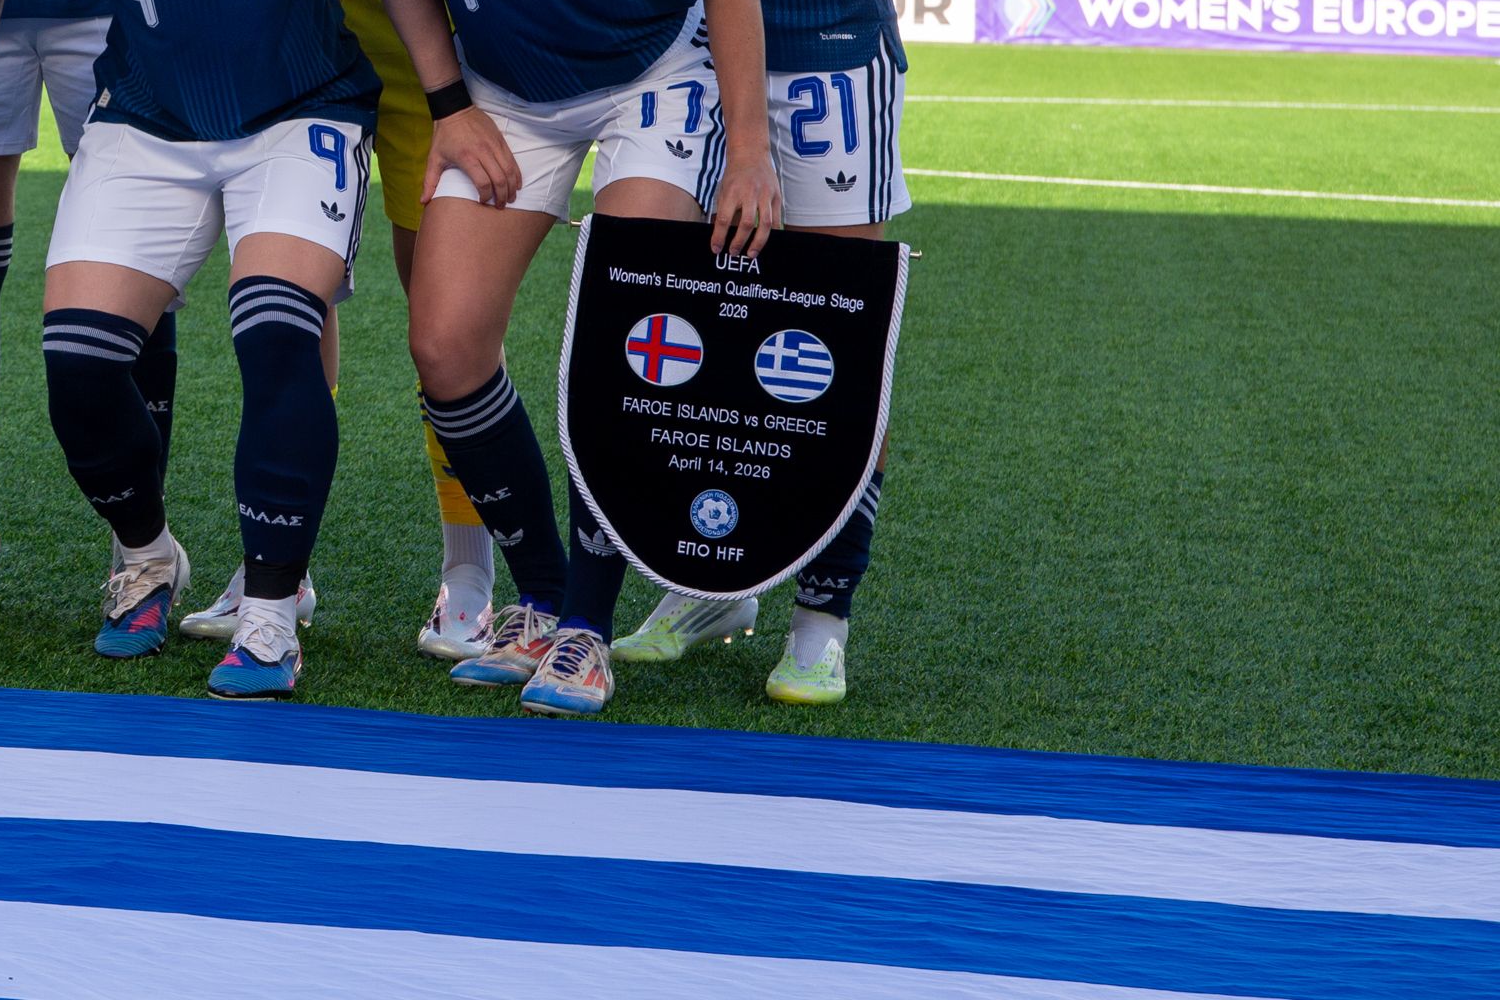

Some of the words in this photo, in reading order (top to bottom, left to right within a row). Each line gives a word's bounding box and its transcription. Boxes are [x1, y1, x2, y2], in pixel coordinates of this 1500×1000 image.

[787, 72, 861, 158] 21
[307, 123, 349, 193] 9
[715, 253, 760, 274] UEFA
[609, 266, 662, 287] Women's
[666, 273, 722, 294] European
[725, 281, 826, 308] Qualifiers-League
[830, 293, 865, 313] Stage
[718, 303, 749, 319] 2026
[622, 396, 672, 416] FAROE
[677, 404, 739, 424] ISLANDS
[744, 415, 759, 427] vs
[763, 415, 827, 436] GREECE
[651, 429, 710, 448] FAROE
[716, 436, 791, 459] ISLANDS
[668, 455, 702, 473] April
[707, 459, 729, 476] 14,
[734, 463, 771, 479] 2026
[239, 503, 304, 527] ΕΛΛΑΣ
[677, 540, 710, 558] ΕΠΟ
[716, 546, 744, 562] HFF
[798, 572, 849, 589] ΛΛΑΣ
